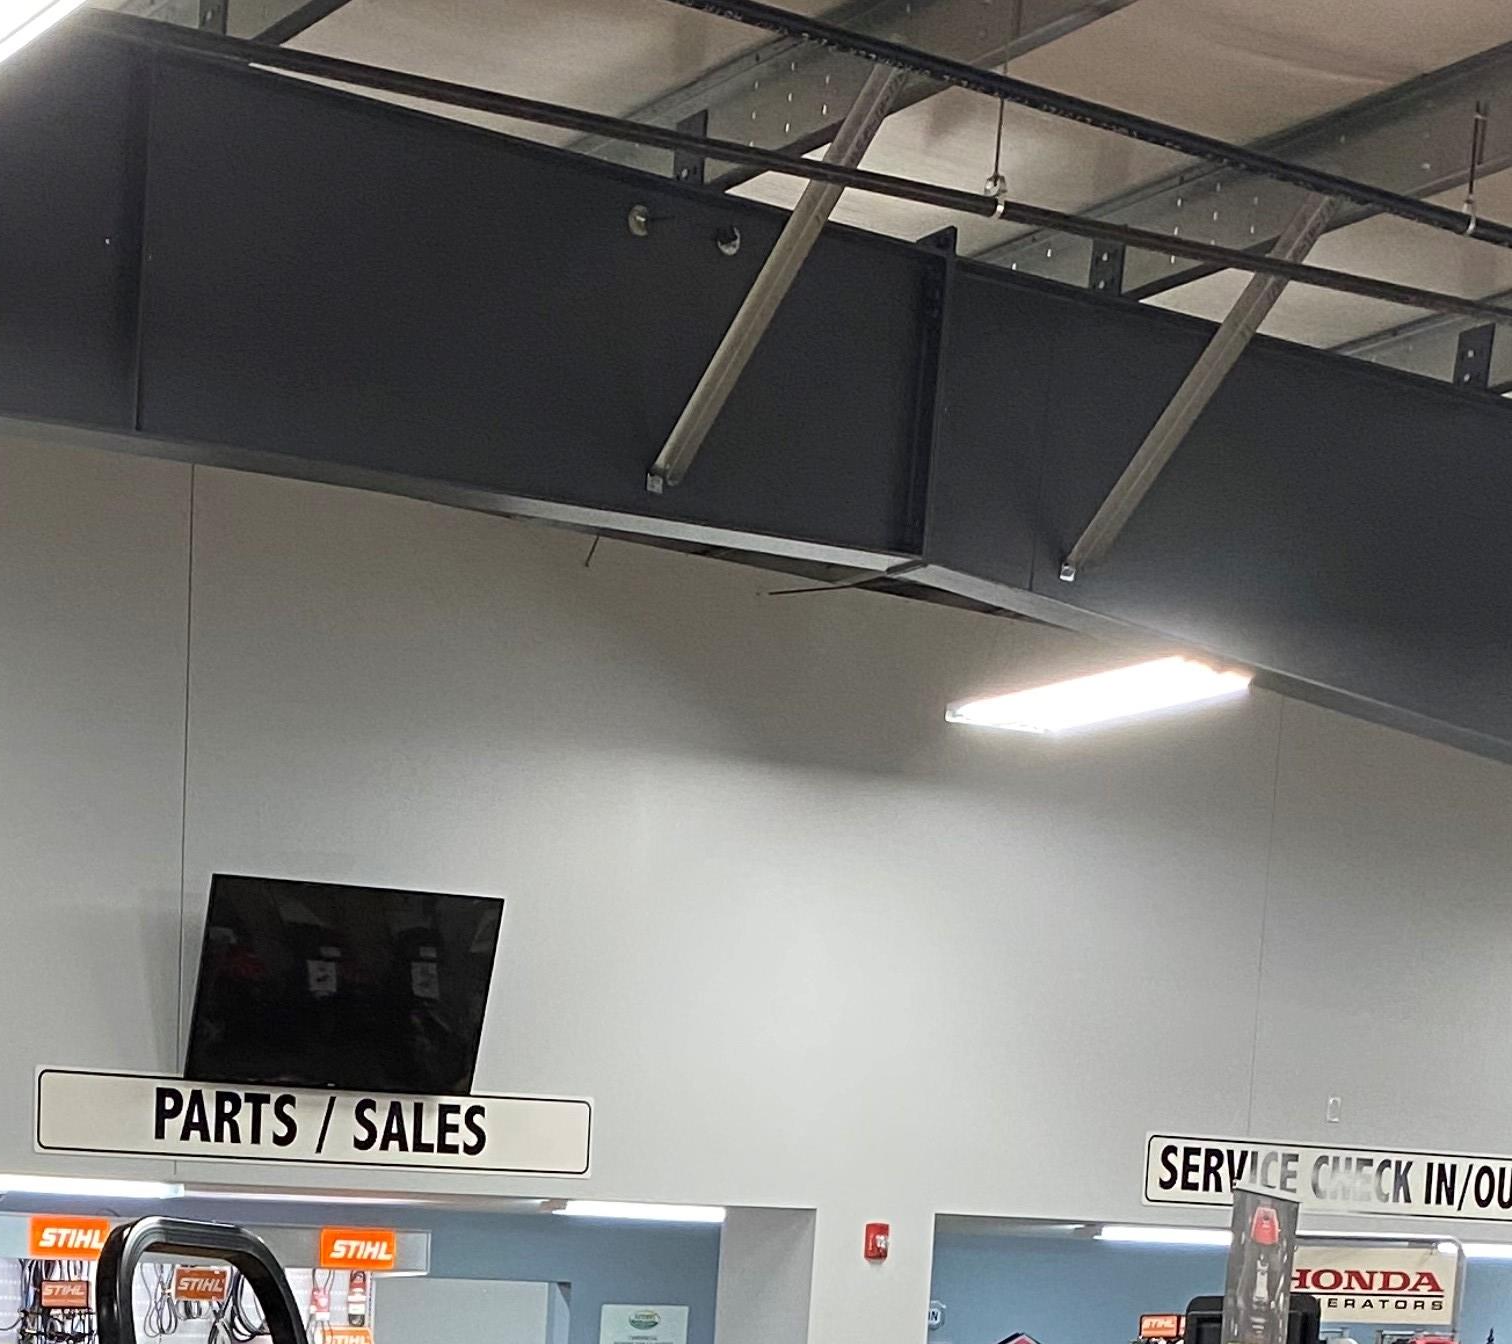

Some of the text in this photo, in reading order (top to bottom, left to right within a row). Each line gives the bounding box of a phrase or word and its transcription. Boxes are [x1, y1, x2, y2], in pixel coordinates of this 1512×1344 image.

[153, 1085, 487, 1156] PARTS / SALES
[1158, 1143, 1512, 1211] SERVICE CHECK IN/OU
[38, 1227, 105, 1251] STIHL
[328, 1238, 394, 1261] STIHL
[42, 1283, 85, 1298] STIHL
[177, 1277, 225, 1294] STIHL
[1291, 1268, 1445, 1293] HONDA
[1327, 1297, 1445, 1312] ERATORS
